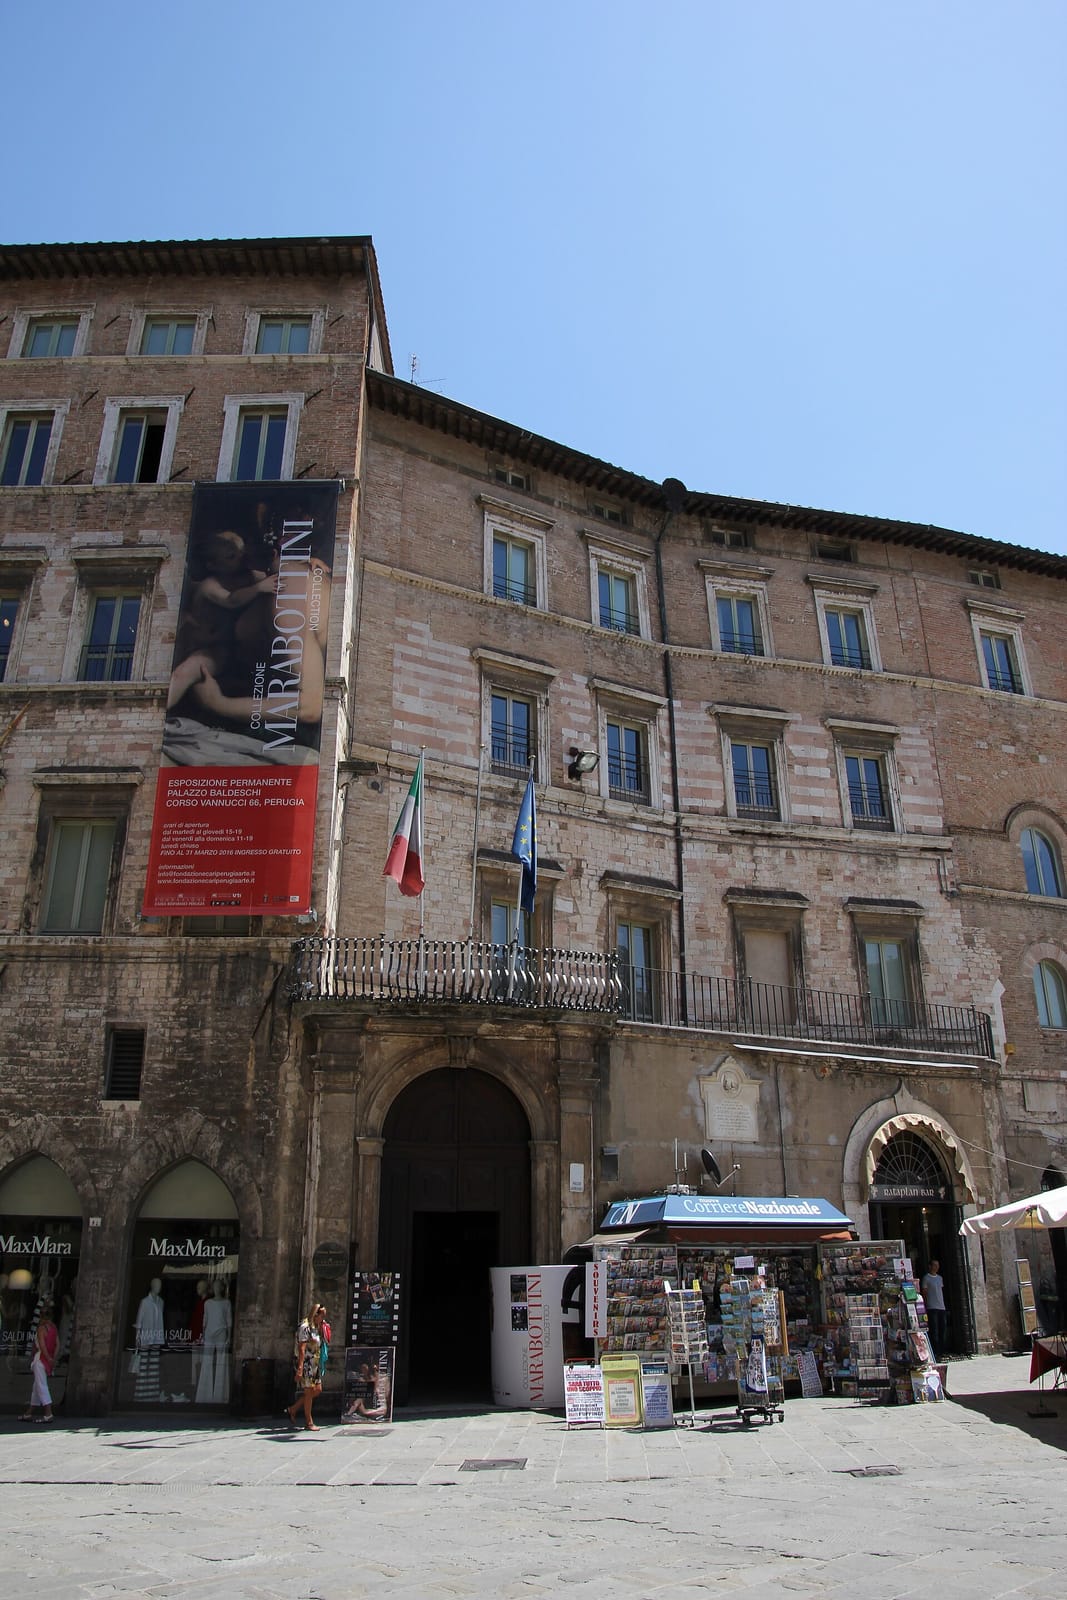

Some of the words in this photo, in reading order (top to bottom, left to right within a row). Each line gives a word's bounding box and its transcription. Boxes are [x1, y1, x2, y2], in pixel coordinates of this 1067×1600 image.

[309, 568, 323, 631] COLLECTION
[263, 518, 314, 753] MARABOTTINI
[250, 662, 266, 730] COLLEZIONE
[168, 779, 228, 787] ESPOSIZIONE
[230, 778, 292, 786] PERMANENTE
[167, 789, 207, 797] PALAZZO
[209, 788, 261, 797] BALDESCHI
[166, 799, 198, 807] CORSO
[200, 799, 247, 807] VANNUCCI
[264, 798, 305, 807] PERUGIA
[268, 848, 302, 856] GRATUITO
[609, 1202, 641, 1225] CN
[0, 1235, 72, 1254] MaxMara
[148, 1238, 226, 1257] MaxMara
[592, 1263, 600, 1337] SOUVENIRS
[2, 1330, 25, 1342] SALDI
[169, 1328, 193, 1341] SALDI
[527, 1274, 544, 1402] MARABOTTINI
